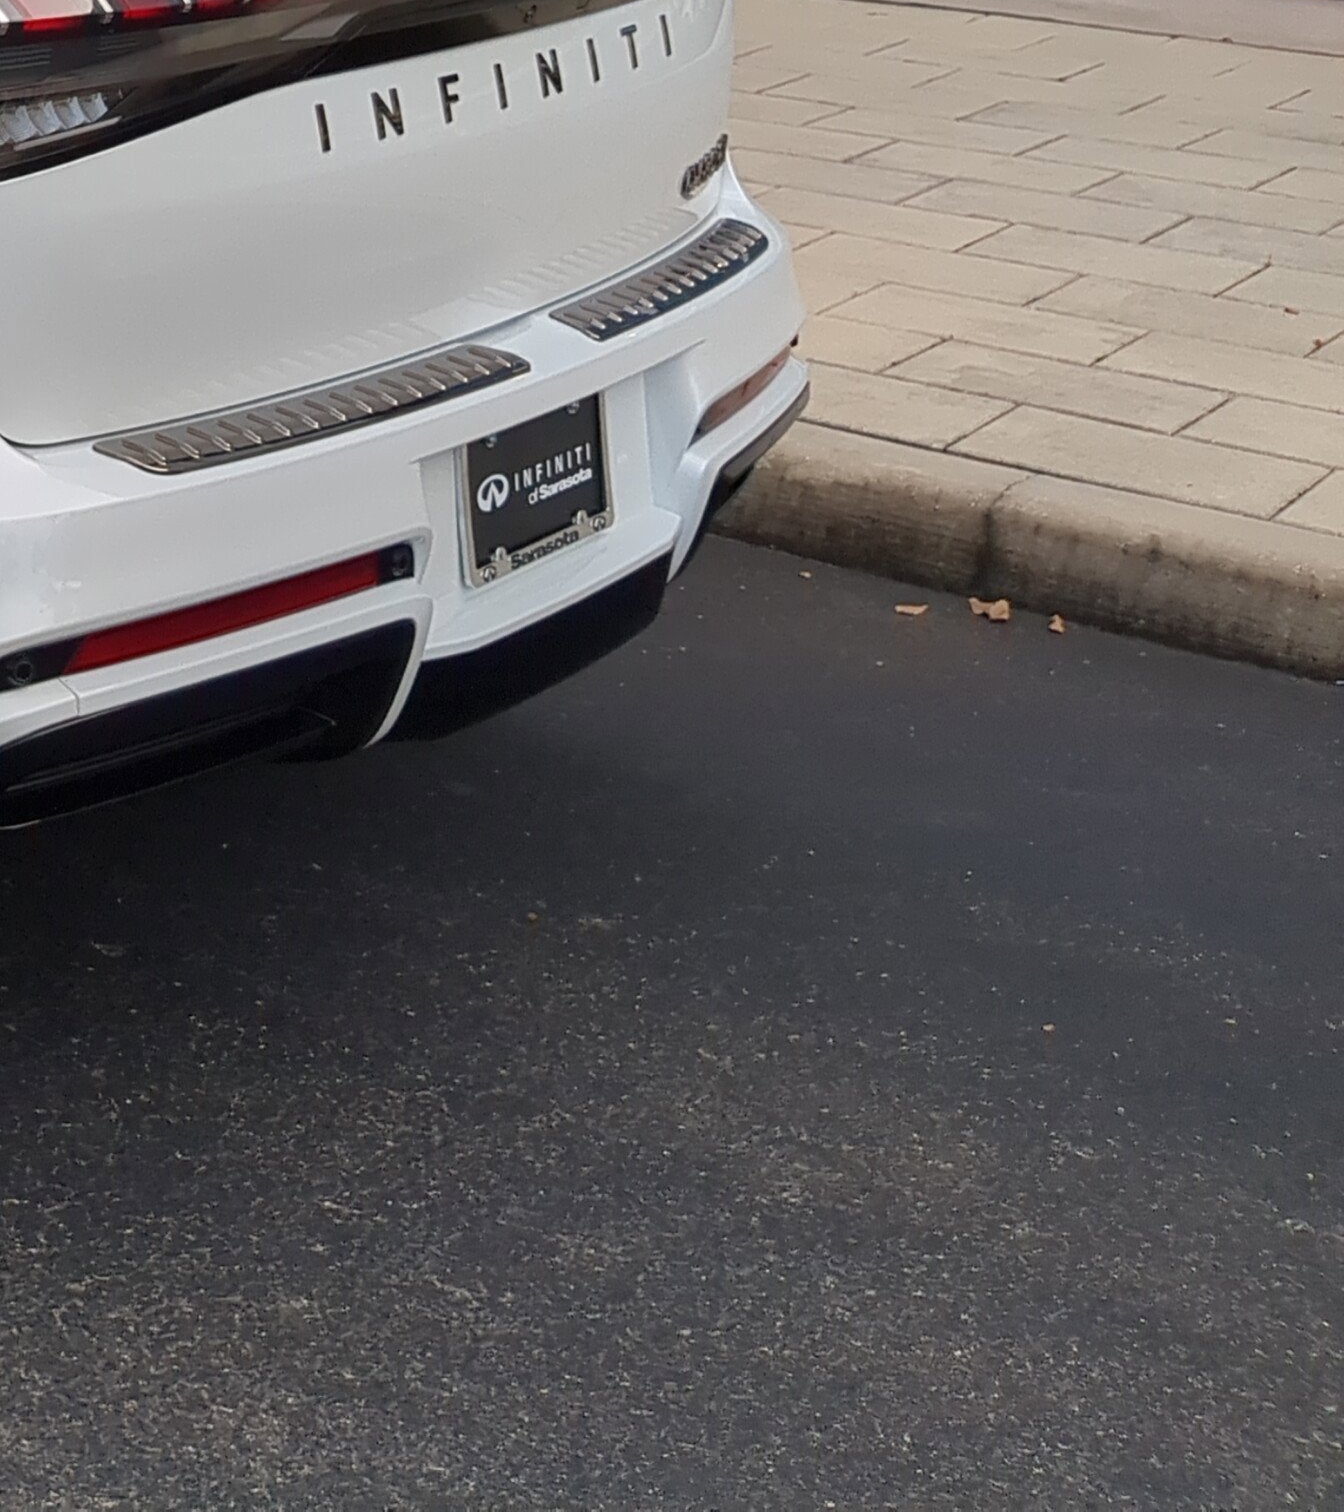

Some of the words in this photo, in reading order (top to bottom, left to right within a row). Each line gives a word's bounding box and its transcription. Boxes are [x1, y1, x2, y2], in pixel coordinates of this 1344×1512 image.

[314, 13, 673, 153] INFINITI
[514, 442, 591, 492] INFINITI
[538, 468, 593, 500] Sarasota
[511, 530, 580, 570] Sarasota
